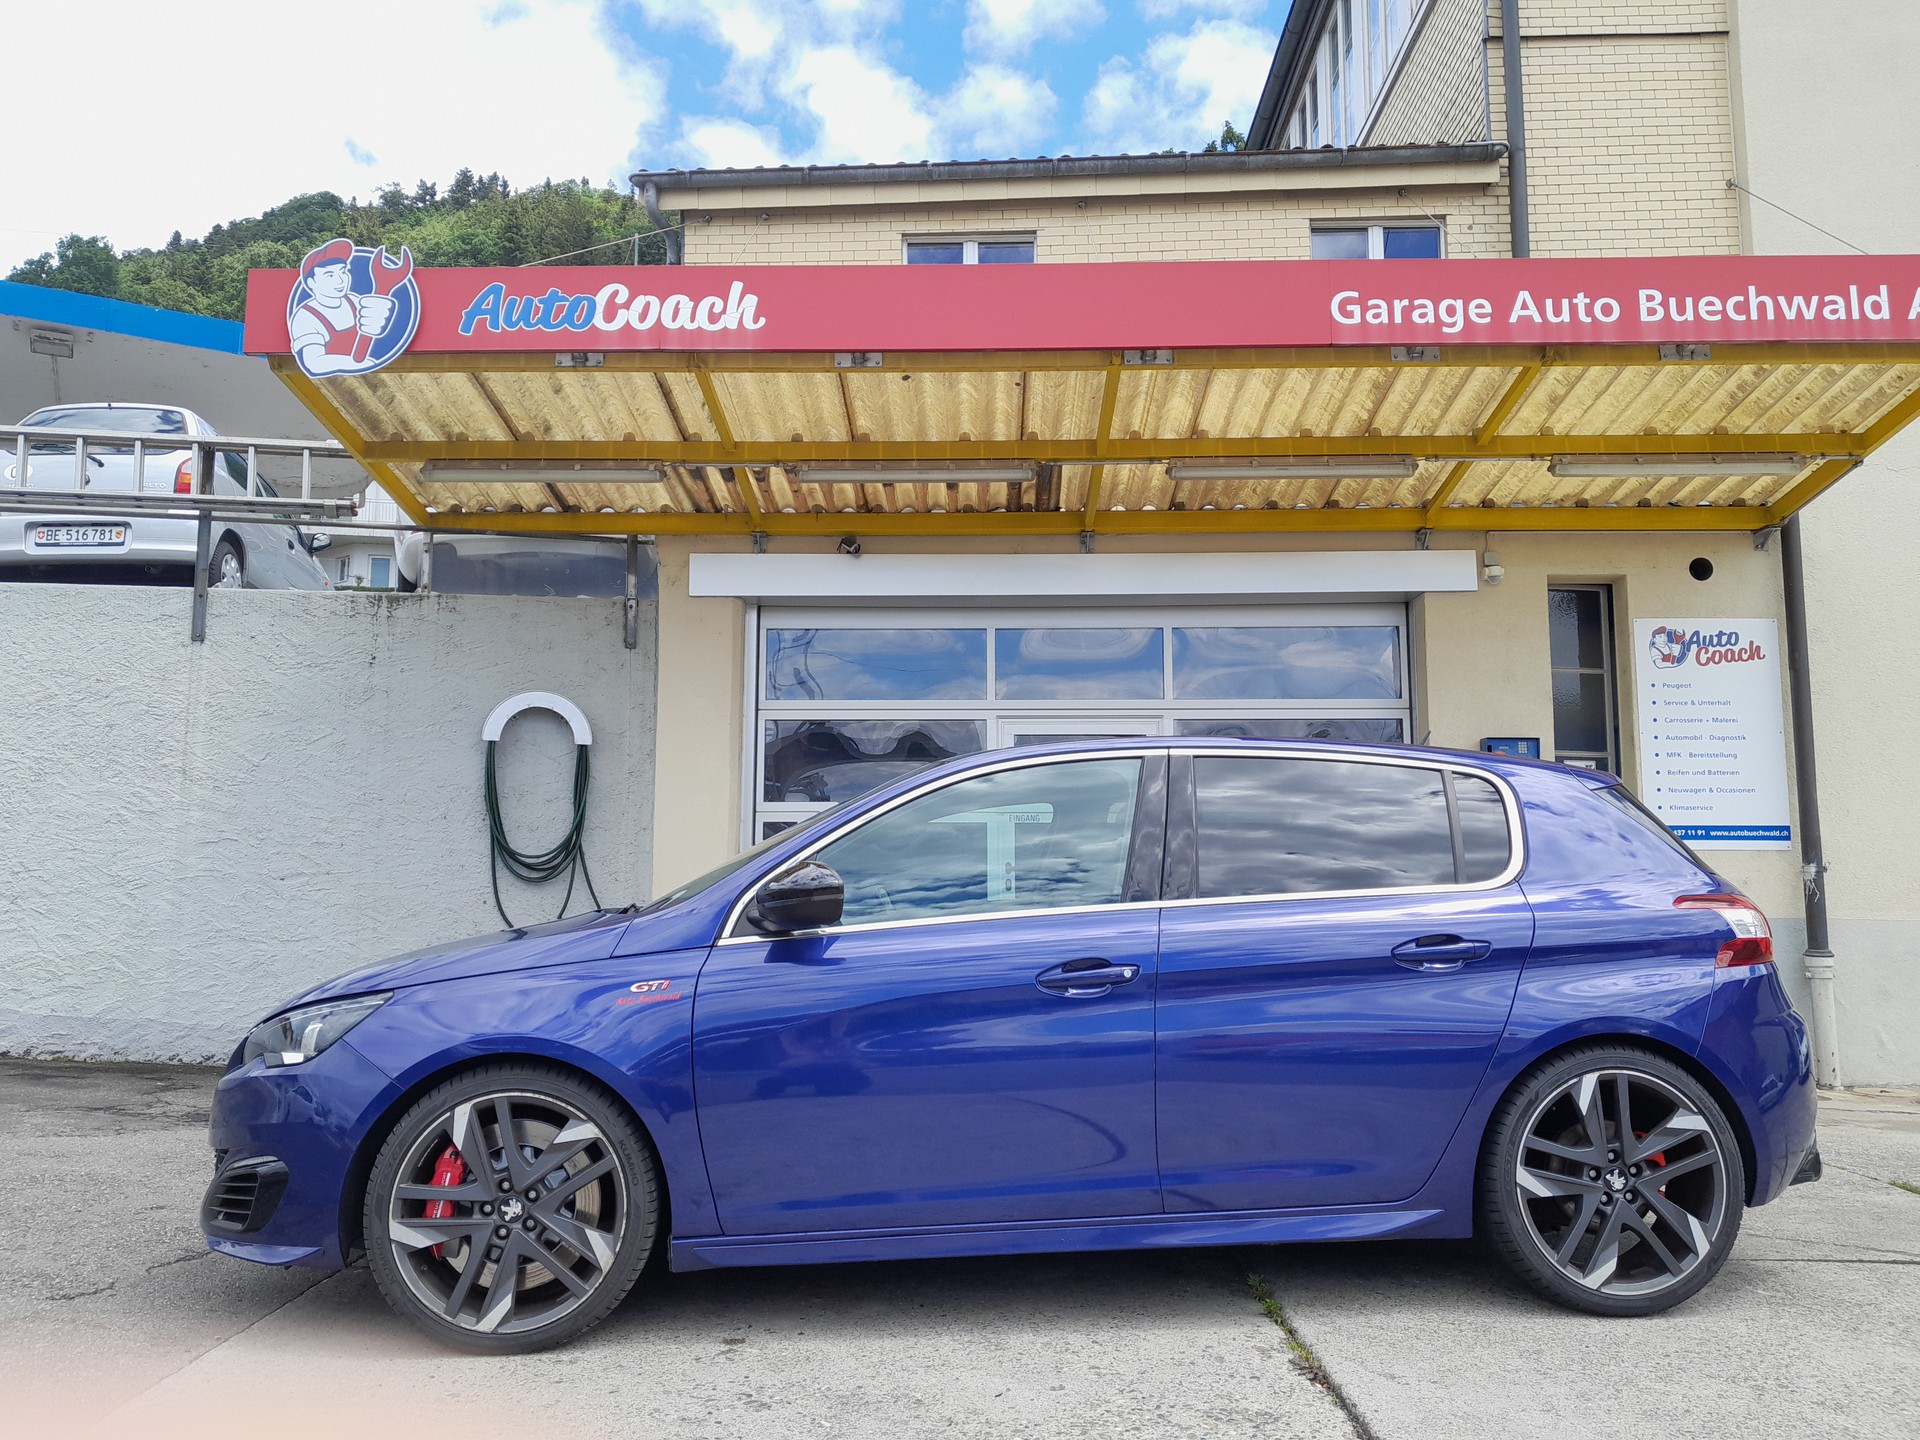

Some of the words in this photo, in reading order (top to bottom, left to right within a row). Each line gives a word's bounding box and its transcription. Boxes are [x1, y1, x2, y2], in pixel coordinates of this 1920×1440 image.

[1330, 290, 1493, 334] Garage
[1508, 289, 1621, 324] Auto
[1639, 284, 1891, 322] Buechwald
[1686, 630, 1740, 650] Auto
[1695, 640, 1766, 667] Coach
[1662, 682, 1692, 690] Peugeot
[1709, 734, 1747, 742] Diagnostik
[1688, 751, 1738, 760] Bereitstellung
[1668, 787, 1707, 795] Neuwagen
[1008, 814, 1041, 822] EINGANG
[1709, 829, 1789, 837] www.autobuechwald.ch
[618, 1139, 640, 1186] KUMHO
